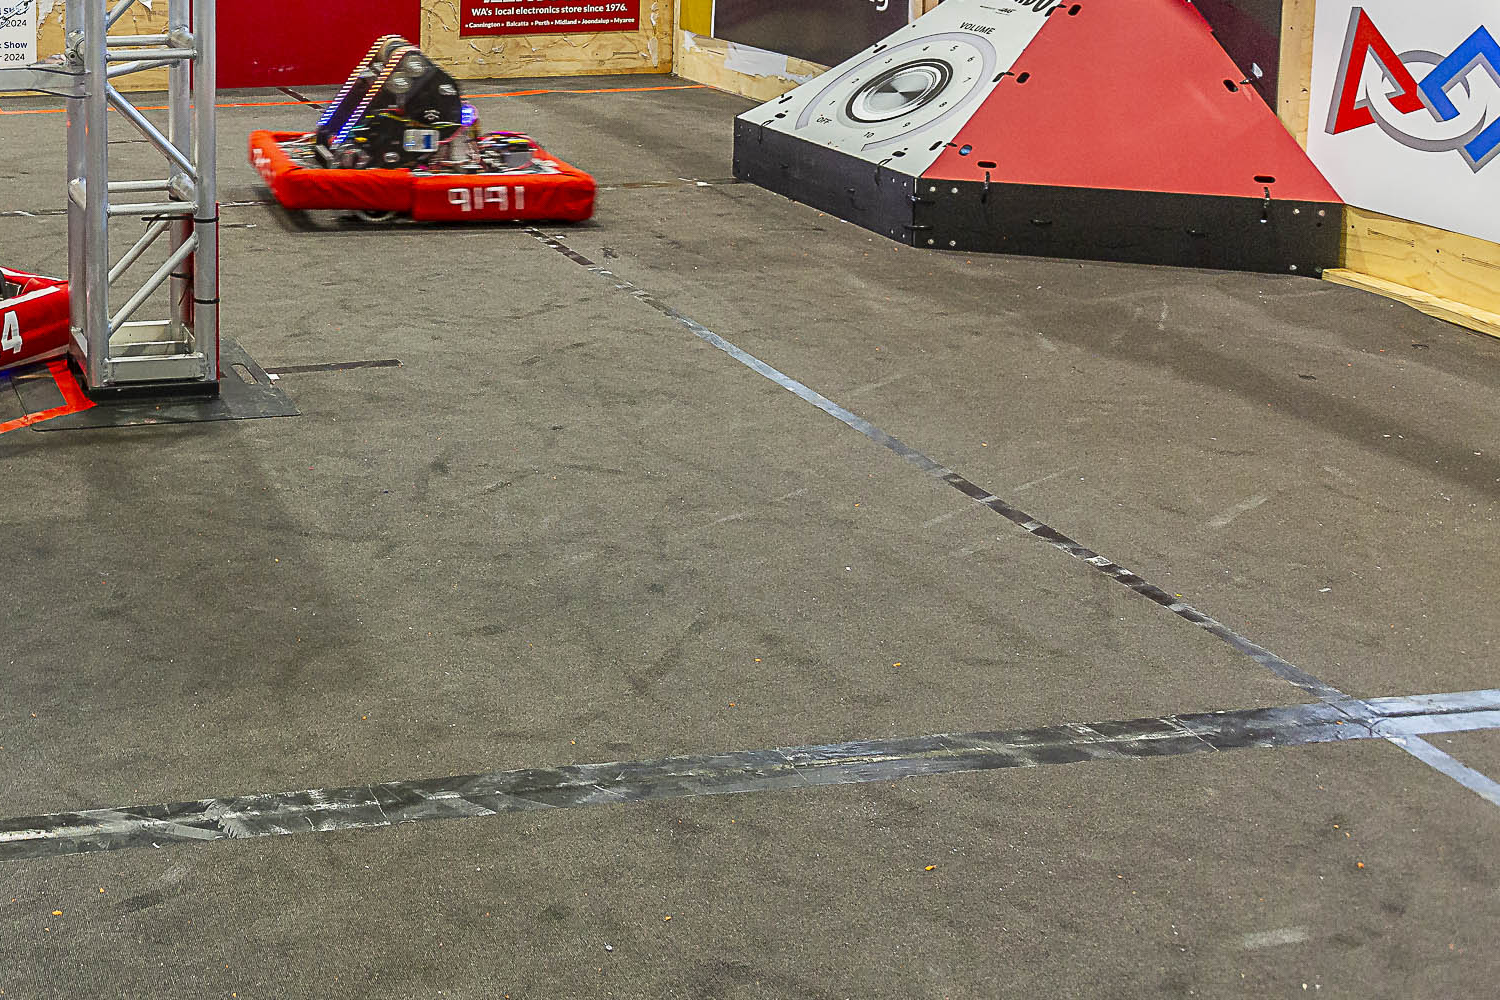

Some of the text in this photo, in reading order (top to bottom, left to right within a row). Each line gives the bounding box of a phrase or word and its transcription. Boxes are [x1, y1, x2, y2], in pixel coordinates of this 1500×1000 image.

[471, 3, 627, 16] WA's local electronics store since 1976.
[6, 19, 27, 28] 2024
[469, 21, 501, 29] Cannington
[581, 18, 610, 26] Joondalup
[613, 17, 635, 25] Myaree
[959, 22, 995, 35] VOLUME
[4, 41, 28, 49] Show
[4, 53, 25, 61] 2024
[817, 117, 832, 125] OFF
[449, 185, 525, 212] 9191
